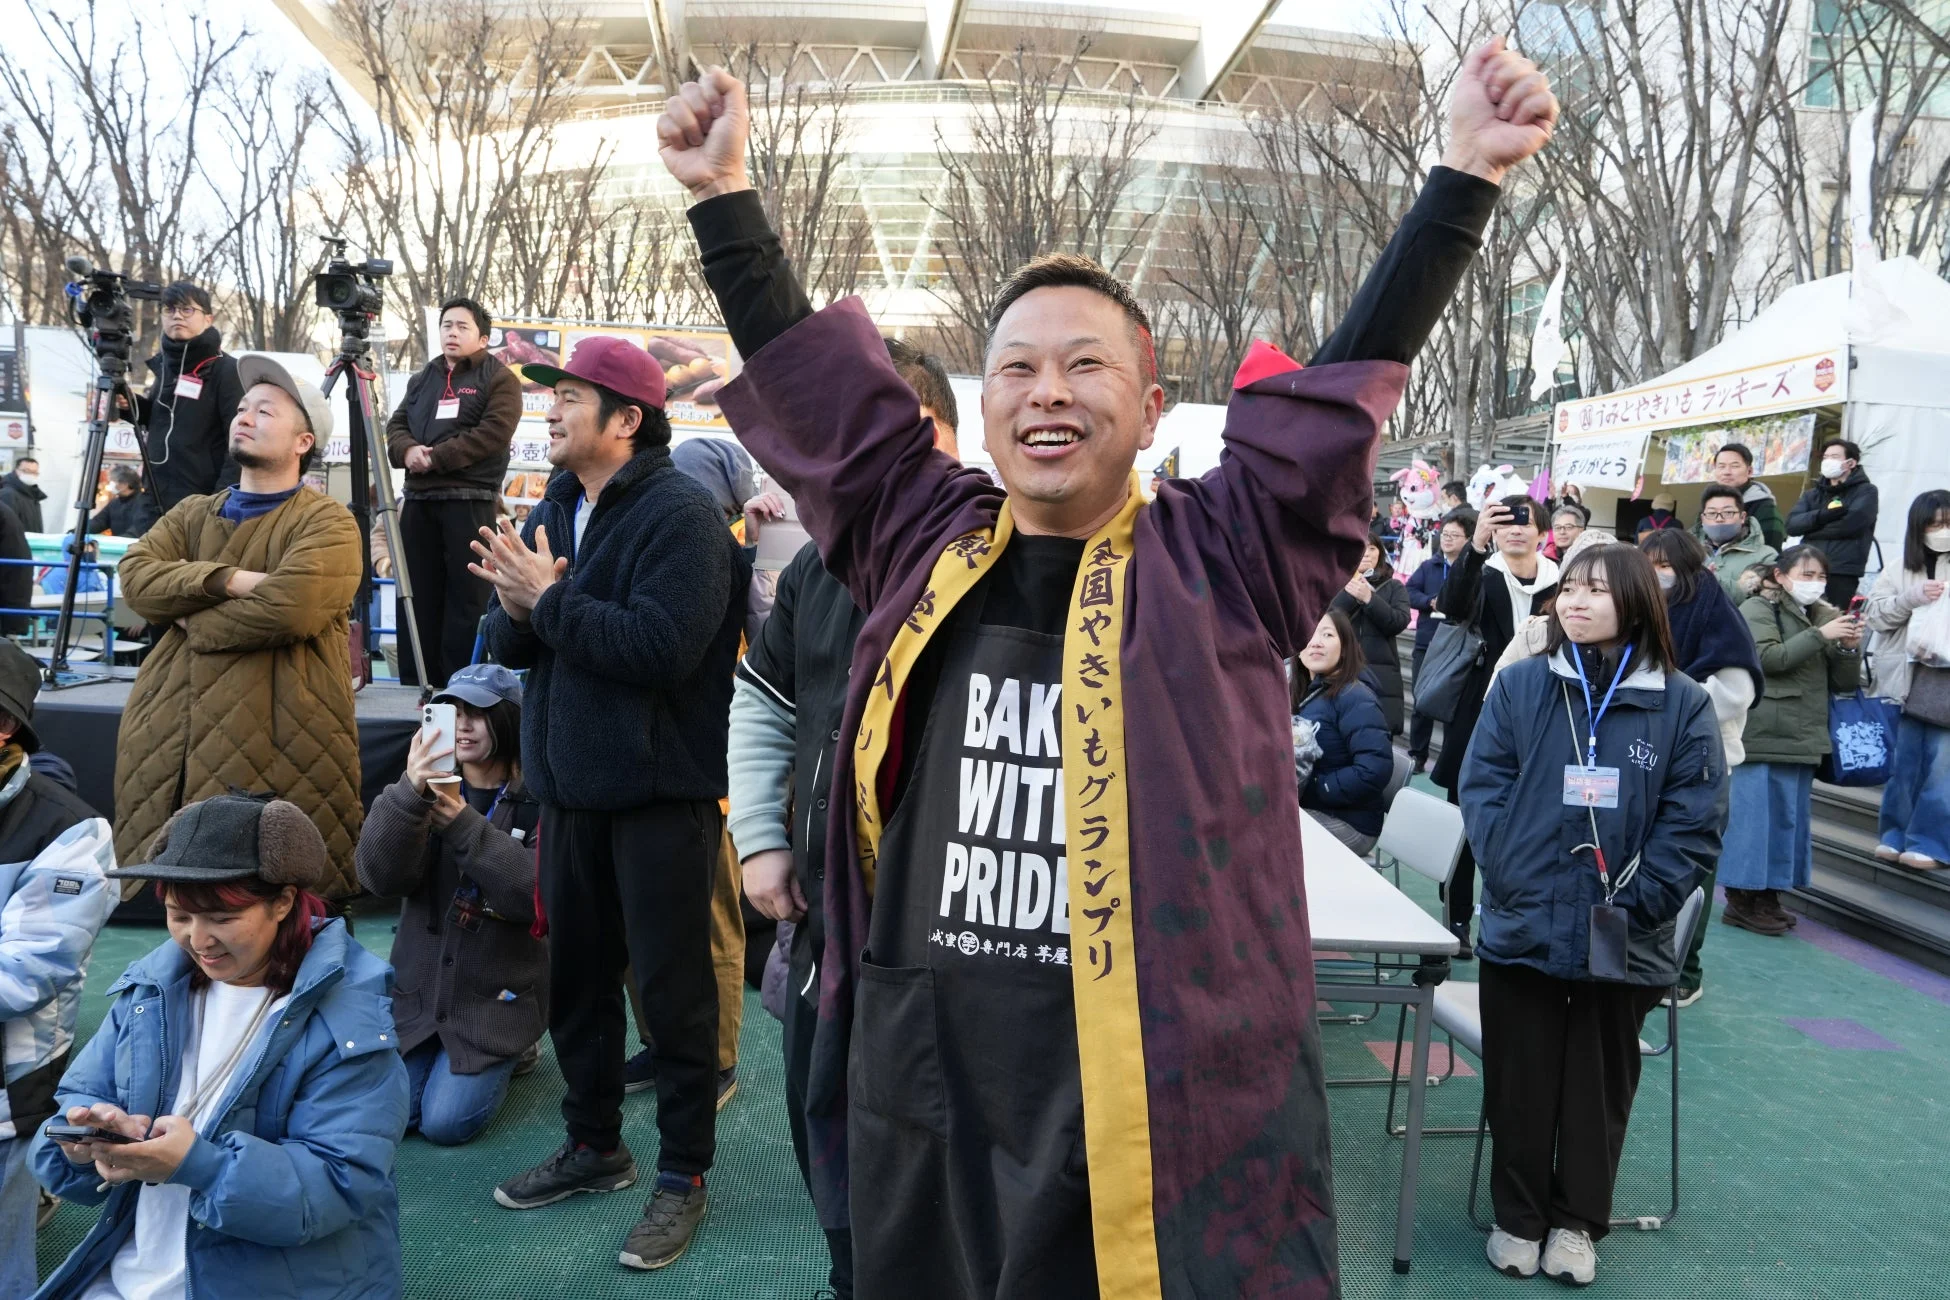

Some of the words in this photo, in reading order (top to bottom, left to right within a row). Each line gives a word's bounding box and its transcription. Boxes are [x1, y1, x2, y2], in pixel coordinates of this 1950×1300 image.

[1703, 364, 1795, 411] ラッキーズ
[1567, 457, 1627, 476] ありがとう
[1076, 537, 1122, 982] 全国やきいもグランプリ
